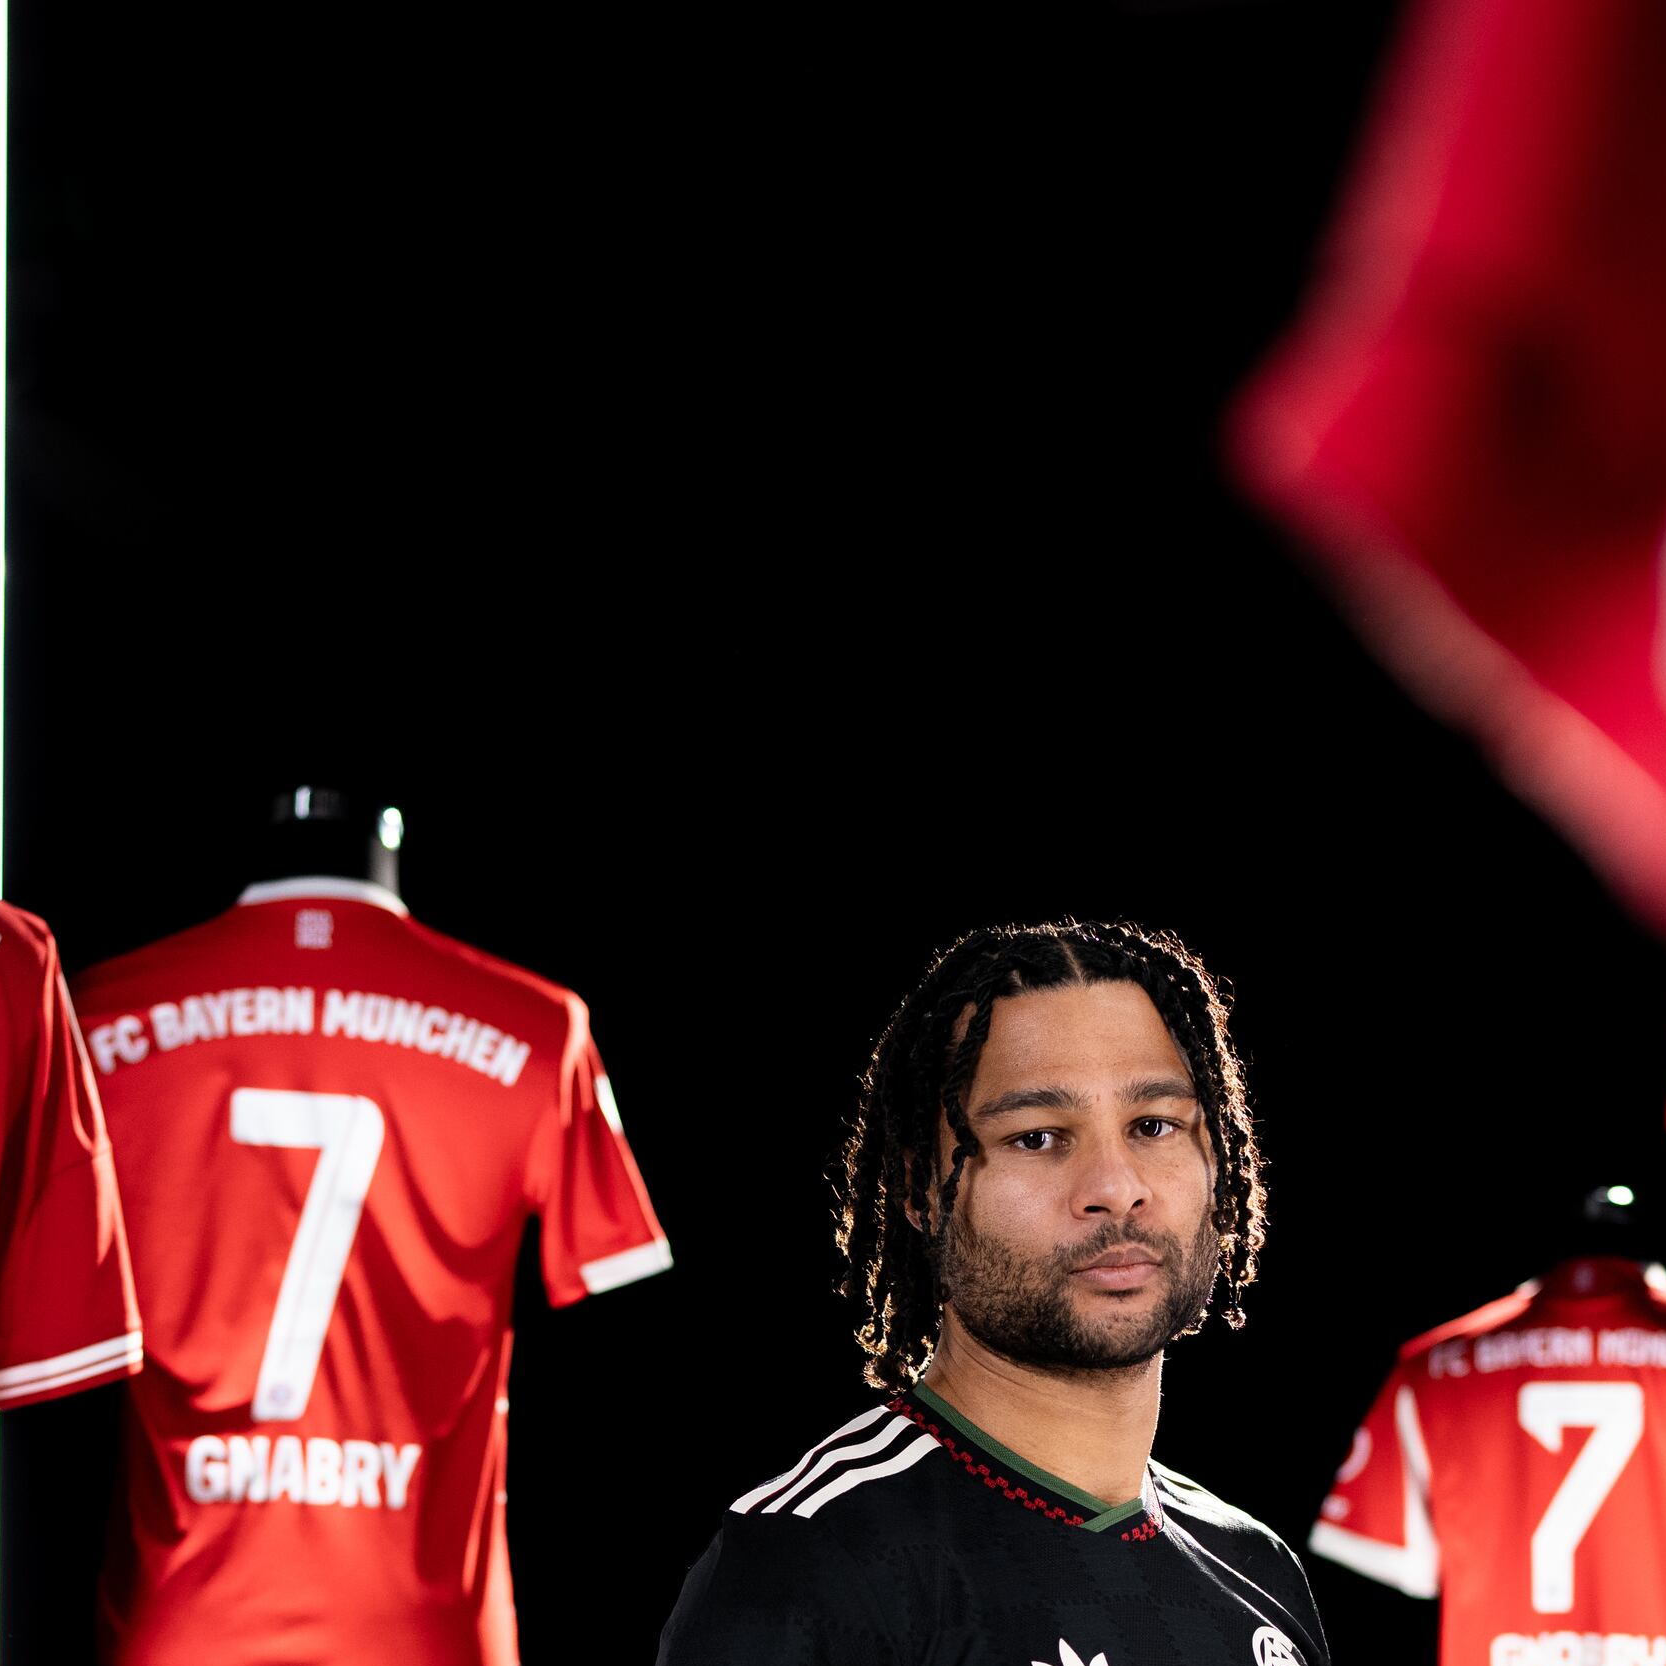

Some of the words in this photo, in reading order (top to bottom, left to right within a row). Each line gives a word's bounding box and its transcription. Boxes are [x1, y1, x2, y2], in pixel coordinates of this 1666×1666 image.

[90, 1014, 150, 1075] FC
[150, 987, 316, 1052] BAYERN
[231, 1088, 386, 1422] 7
[186, 1435, 422, 1510] GNABRY
[1519, 1382, 1646, 1615] 7
